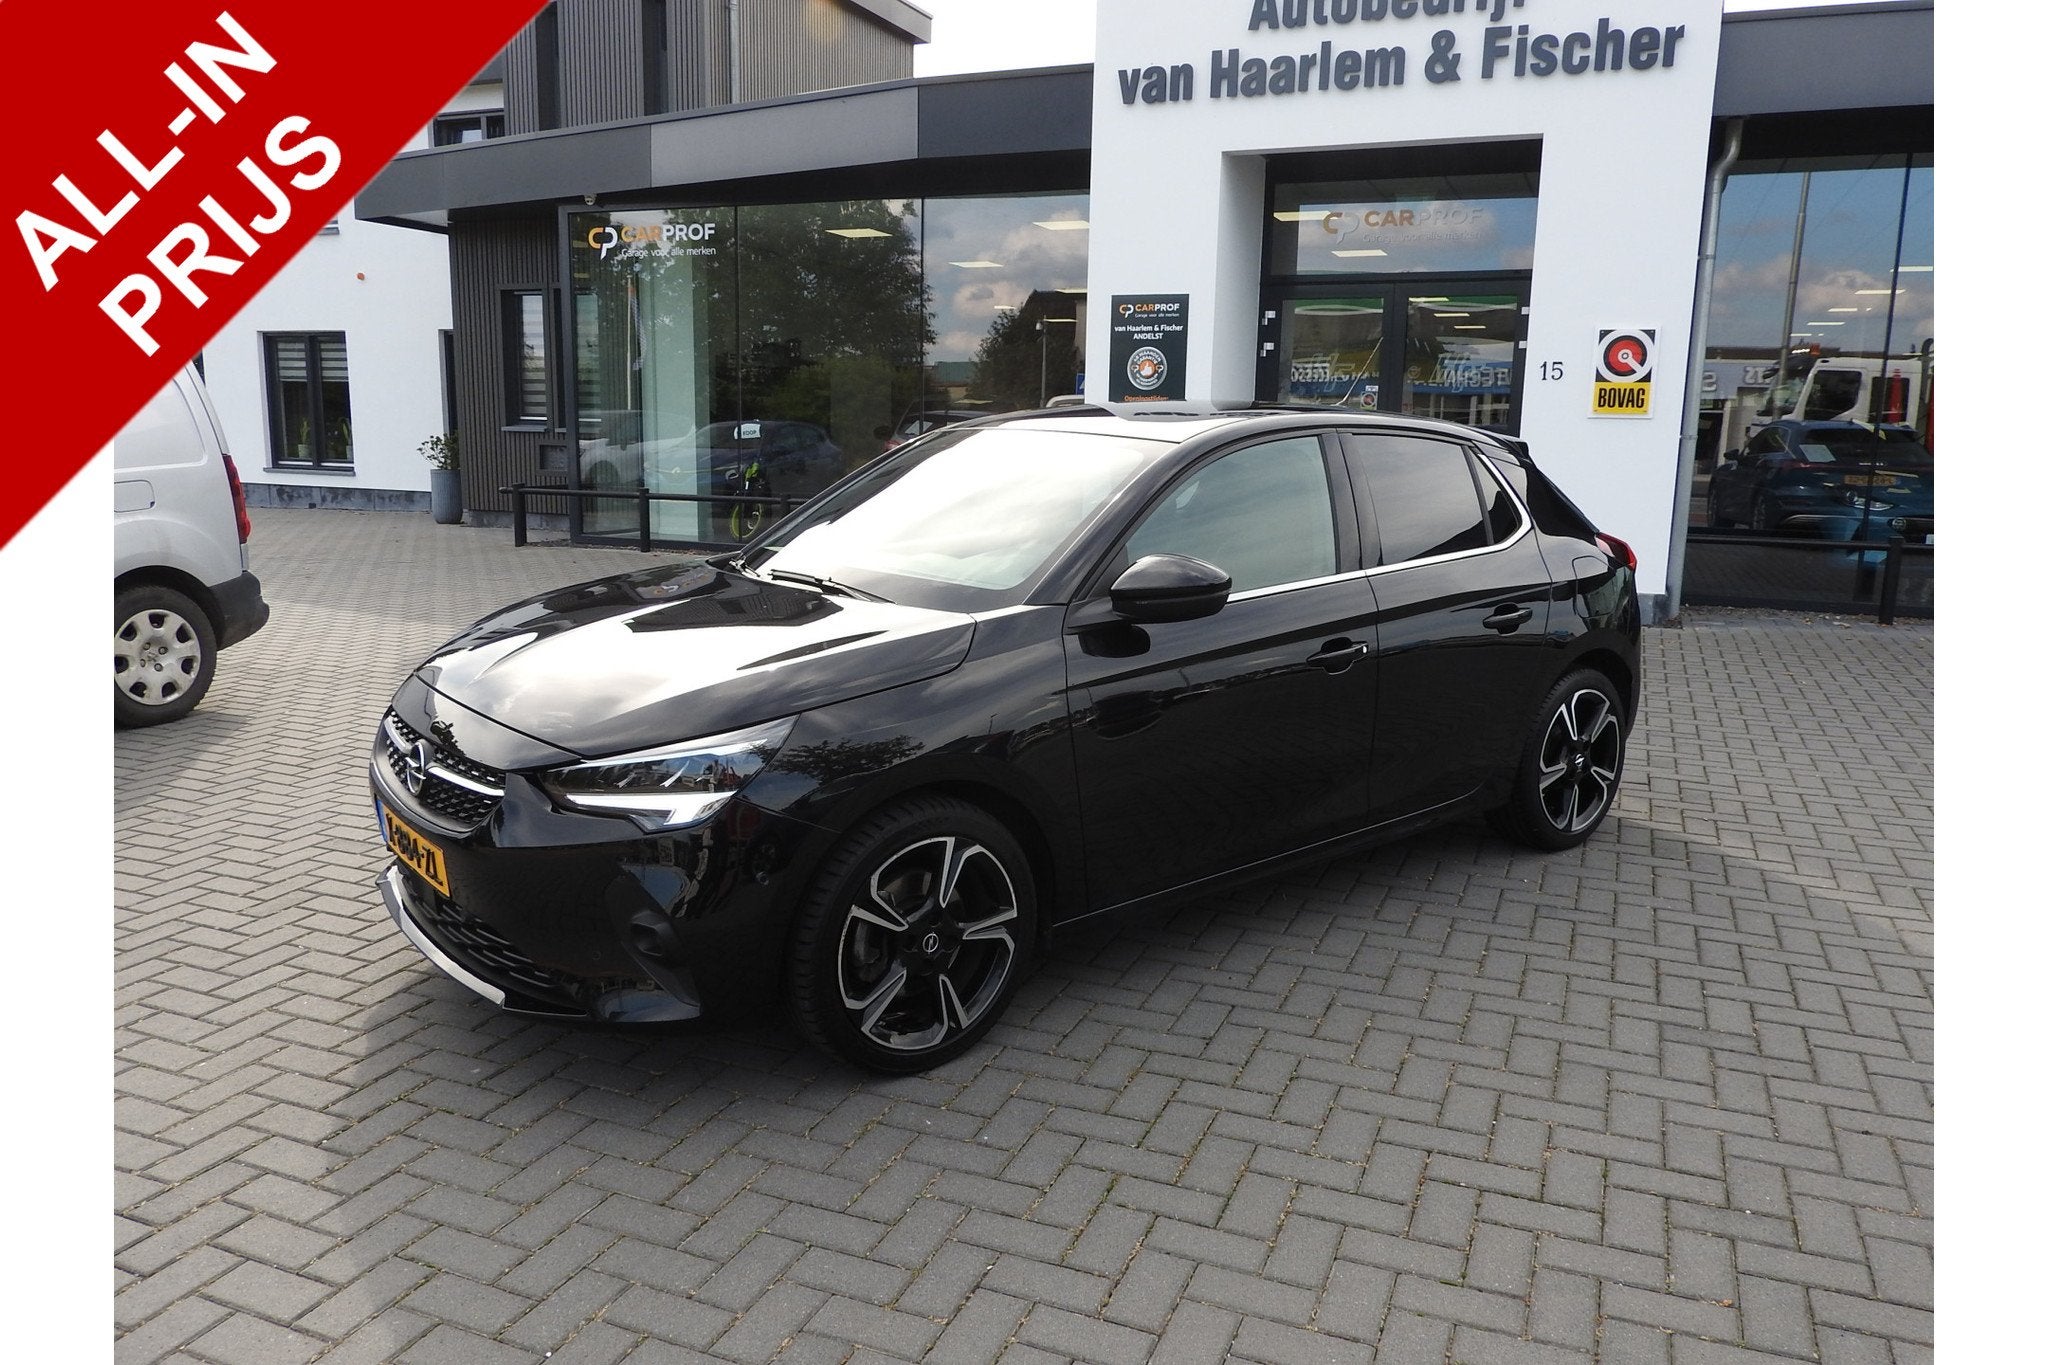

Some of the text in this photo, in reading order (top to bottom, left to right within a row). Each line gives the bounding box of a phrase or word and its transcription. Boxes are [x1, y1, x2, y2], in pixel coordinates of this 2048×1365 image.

[1118, 18, 1686, 105] van Haarlem & Fischer
[621, 223, 716, 243] CARPROF
[621, 248, 649, 259] Garage
[671, 247, 685, 256] alle
[686, 247, 717, 256] merken
[1135, 303, 1180, 312] CARPROF
[1127, 324, 1153, 332] Haarlem
[1133, 332, 1164, 340] ANDELST
[1540, 361, 1564, 381] 15
[1598, 387, 1646, 408] BOVAG
